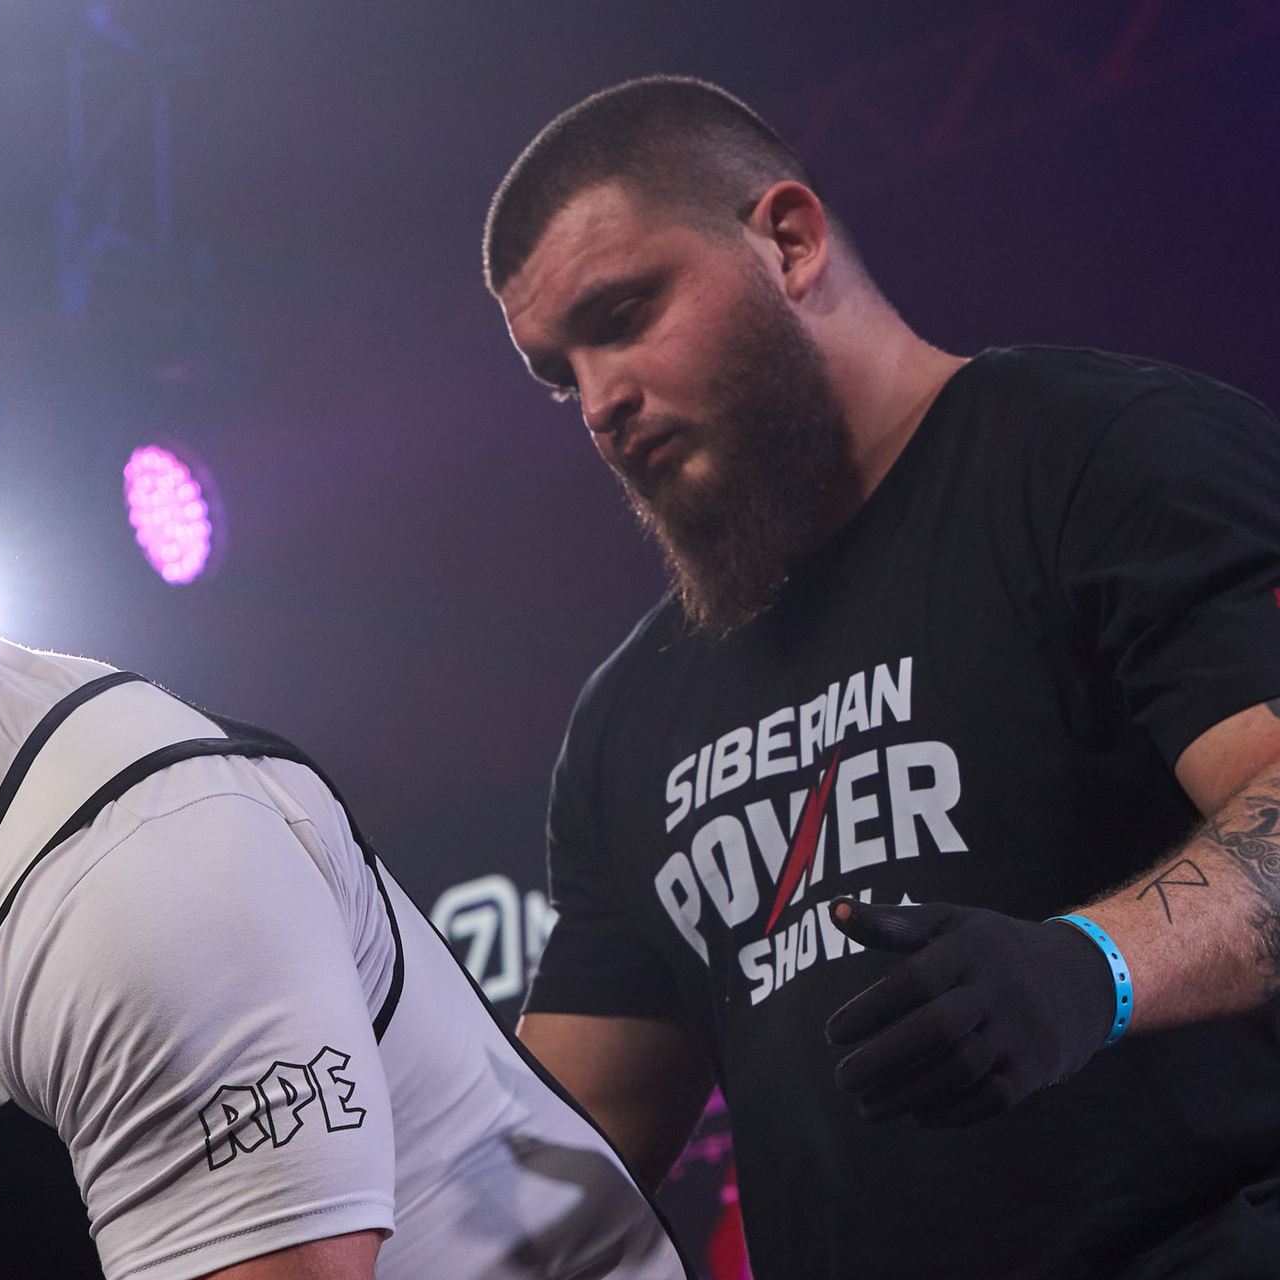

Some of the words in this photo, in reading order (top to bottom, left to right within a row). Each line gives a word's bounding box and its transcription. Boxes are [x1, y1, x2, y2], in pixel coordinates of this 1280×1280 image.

[665, 656, 913, 834] SIBERIAN
[654, 740, 970, 968] POWER
[198, 1045, 367, 1171] RPE
